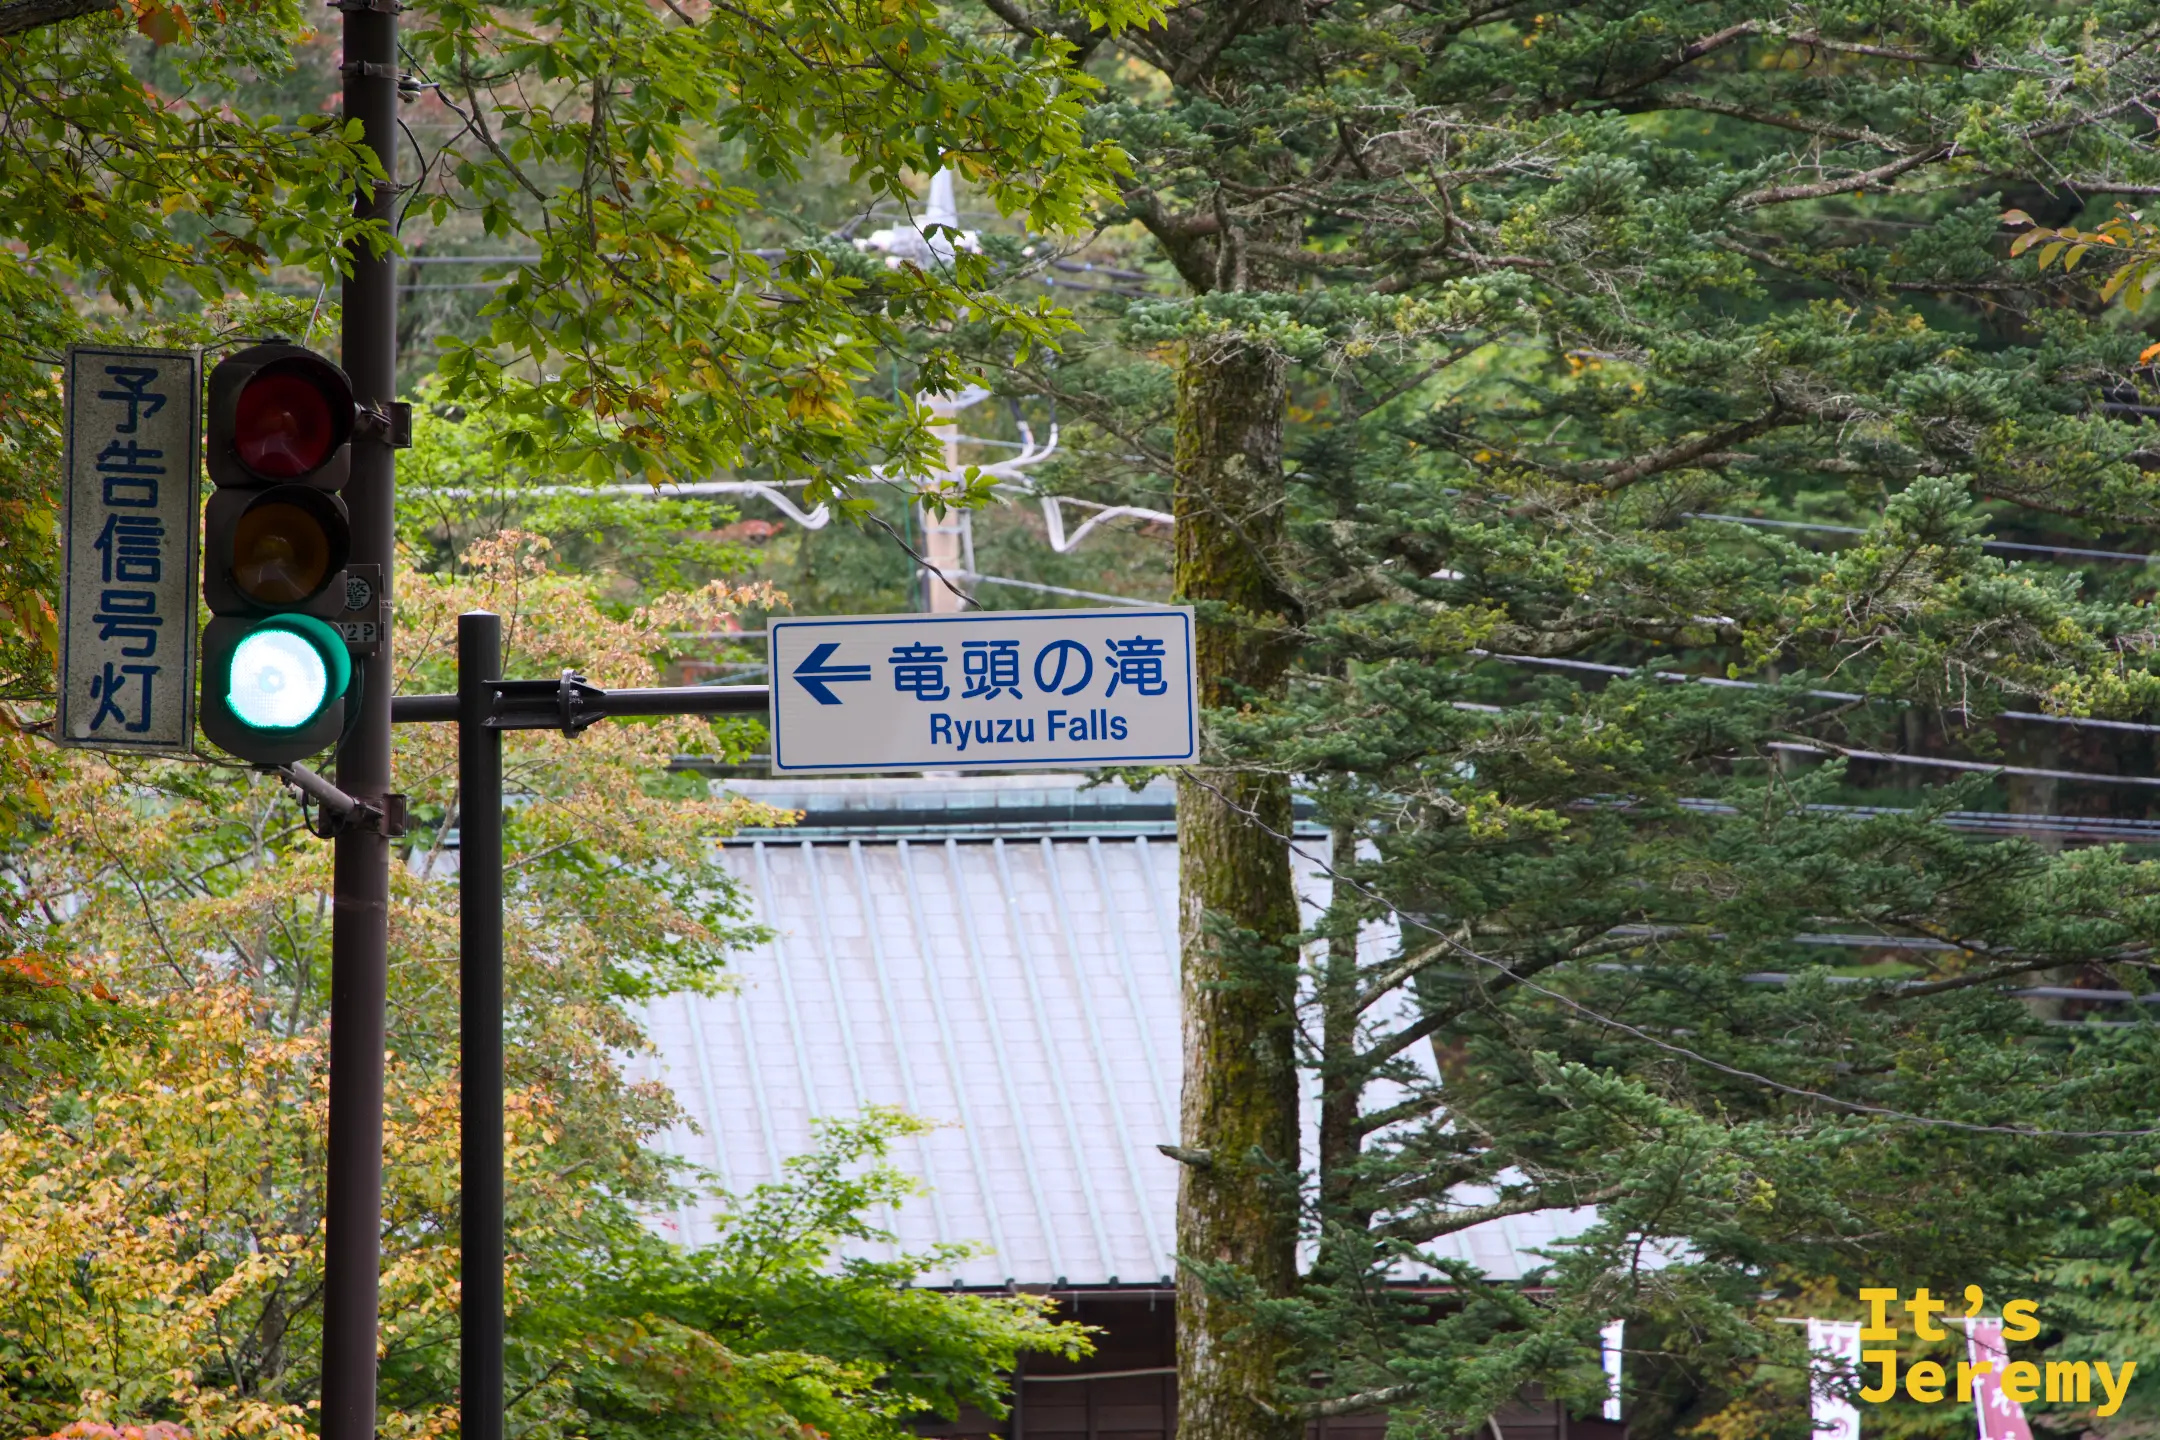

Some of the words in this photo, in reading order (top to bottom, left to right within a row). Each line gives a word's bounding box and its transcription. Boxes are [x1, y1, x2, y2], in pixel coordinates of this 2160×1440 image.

[90, 365, 167, 733] 予告信号灯
[888, 635, 1168, 701] 竜頭の滝
[930, 713, 1034, 751] Ryuzu
[1048, 708, 1128, 741] Falls
